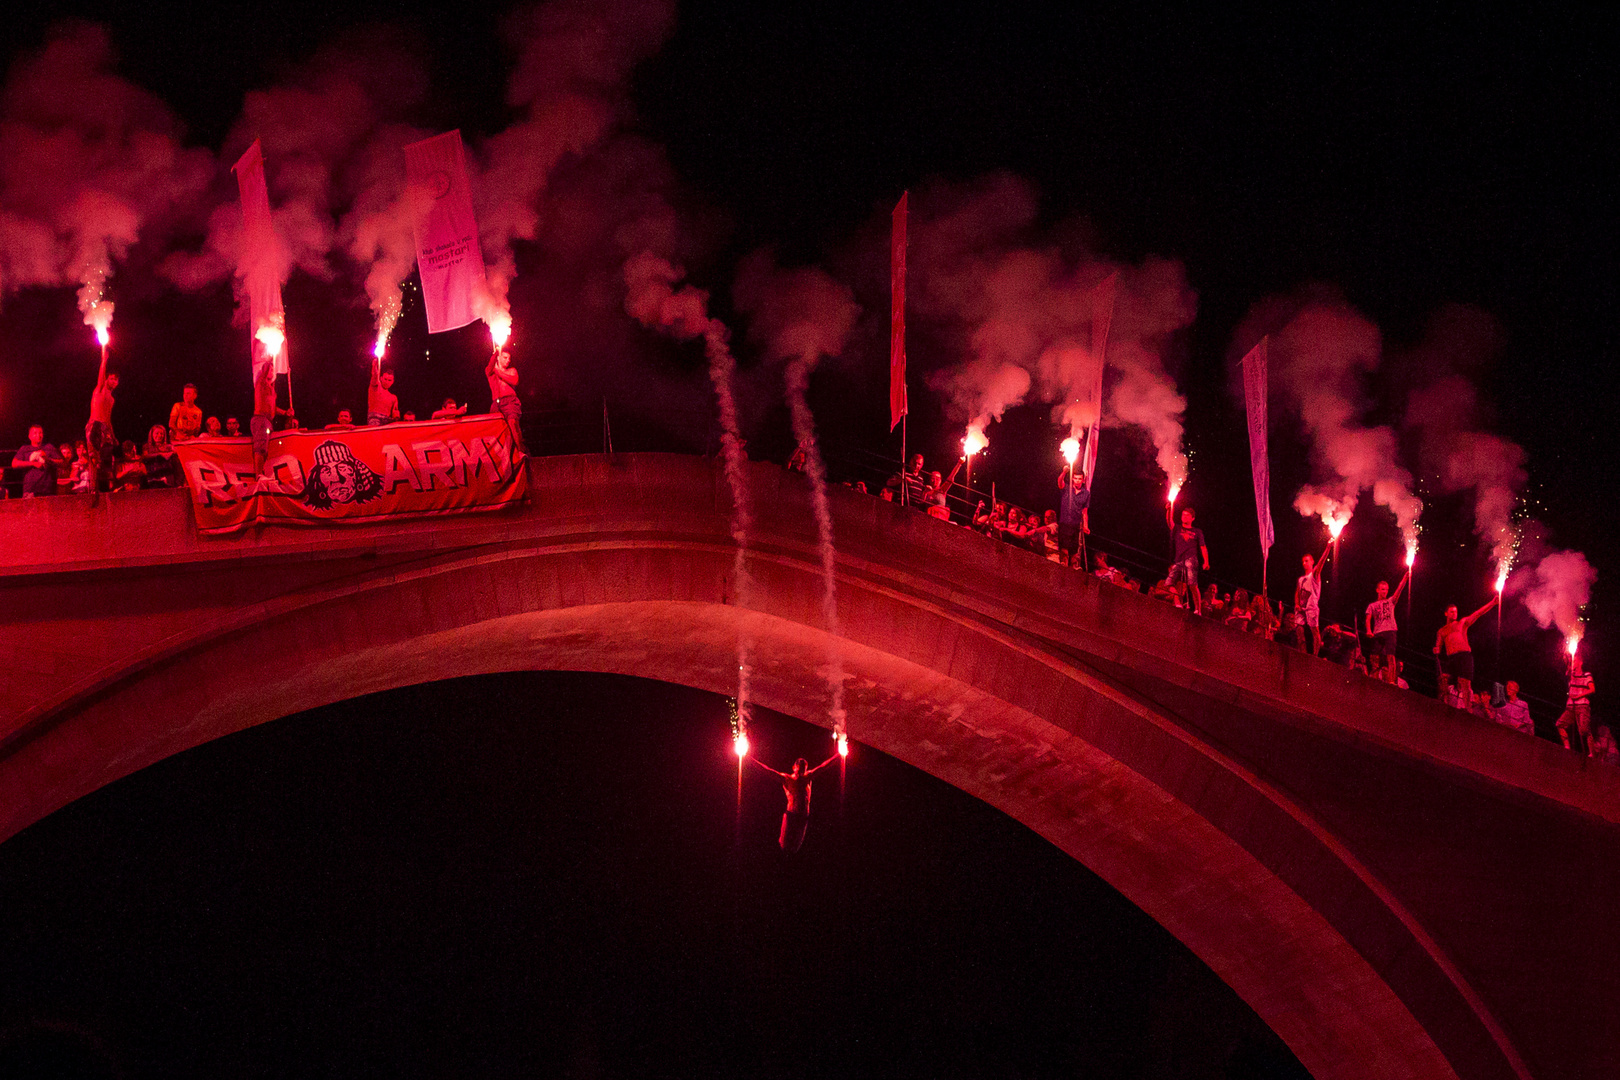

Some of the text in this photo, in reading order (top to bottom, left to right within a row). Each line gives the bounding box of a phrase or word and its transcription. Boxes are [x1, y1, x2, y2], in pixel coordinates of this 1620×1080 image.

[428, 245, 470, 264] mostari
[185, 435, 513, 505] RED ARMY
